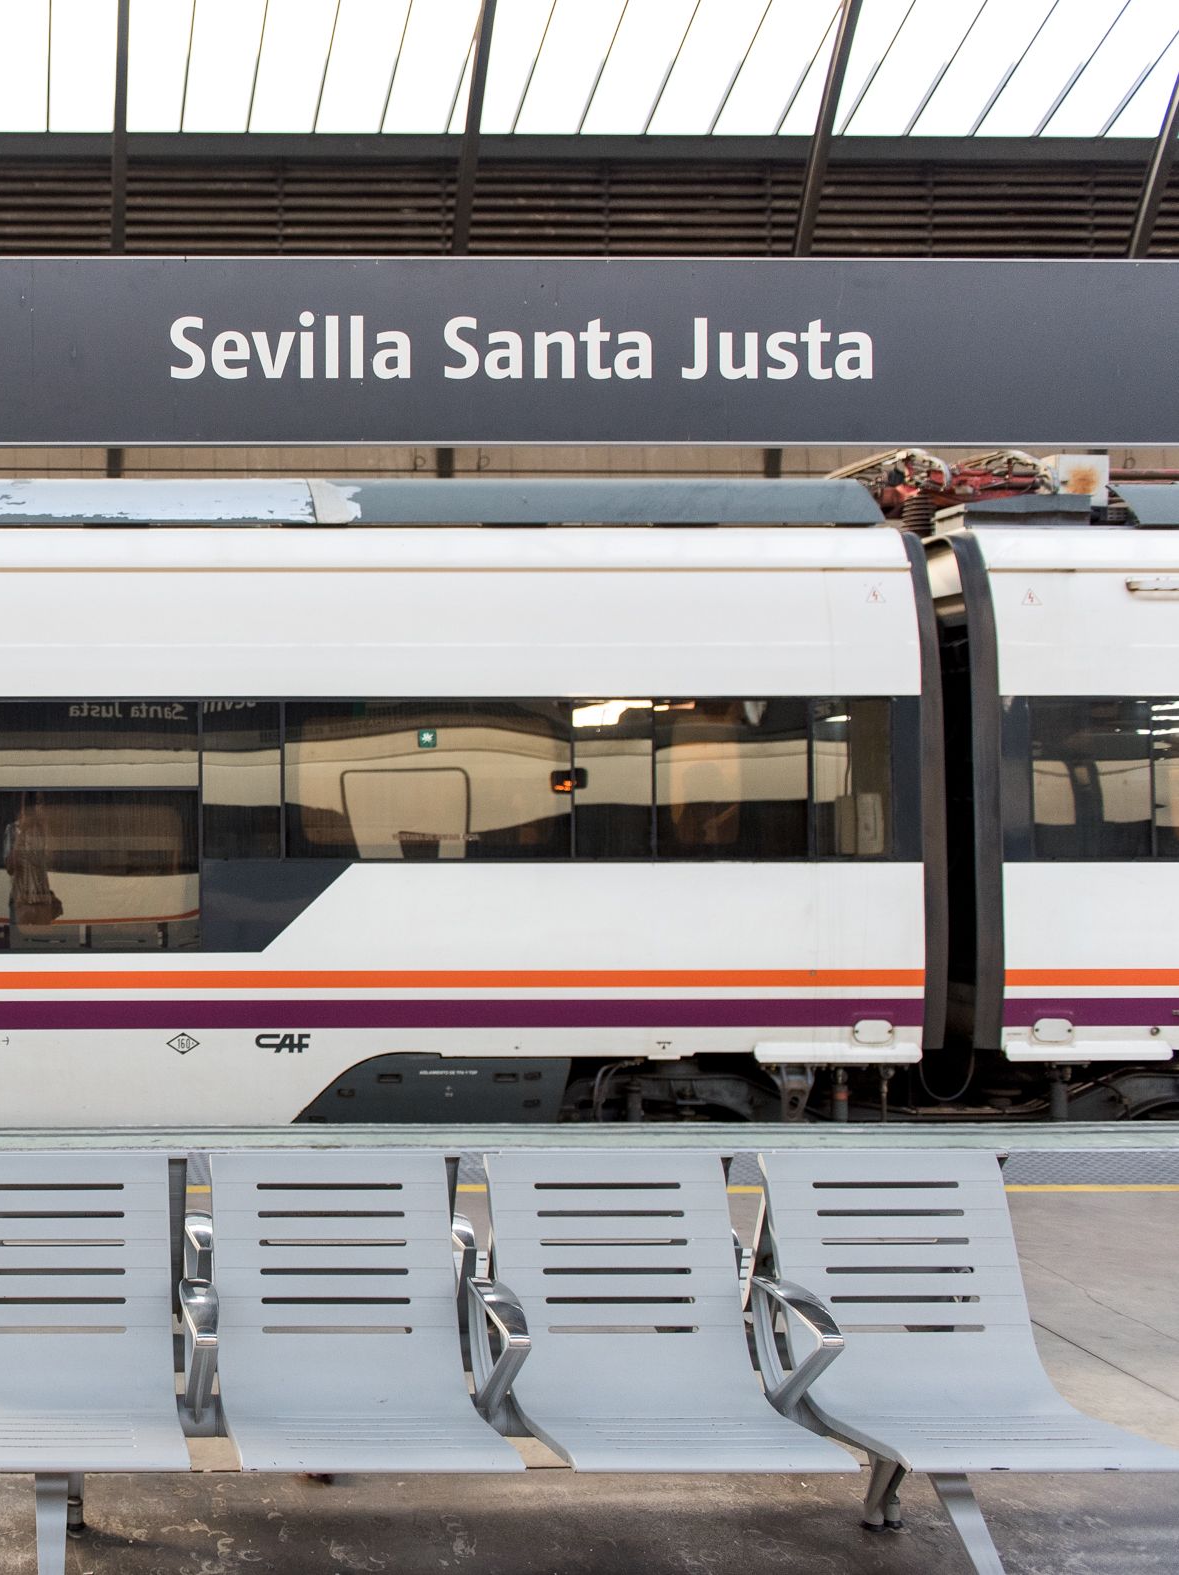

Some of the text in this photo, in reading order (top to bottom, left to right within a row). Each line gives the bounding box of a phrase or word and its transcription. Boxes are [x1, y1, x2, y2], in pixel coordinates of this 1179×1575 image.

[170, 311, 872, 379] Sevilla Santa Justa
[177, 1038, 191, 1049] 160
[255, 1034, 310, 1053] CAF
